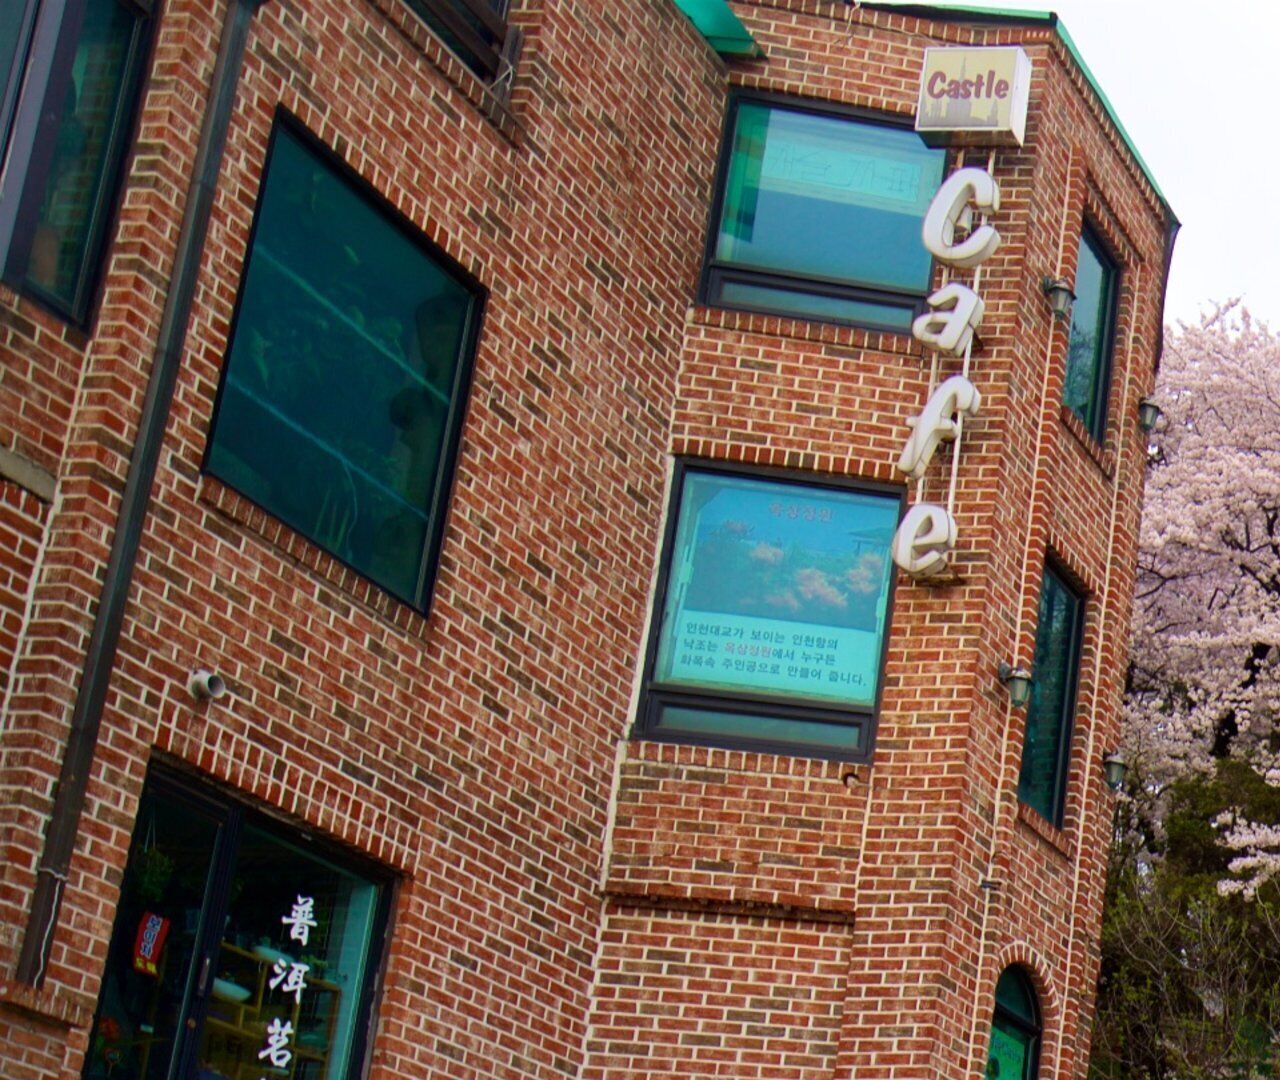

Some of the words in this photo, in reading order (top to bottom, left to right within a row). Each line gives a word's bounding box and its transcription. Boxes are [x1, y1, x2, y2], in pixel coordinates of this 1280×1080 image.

[926, 69, 1009, 101] Castle
[891, 165, 1001, 579] Cafe
[686, 622, 744, 639] 인천대교가
[750, 630, 785, 644] 보이는
